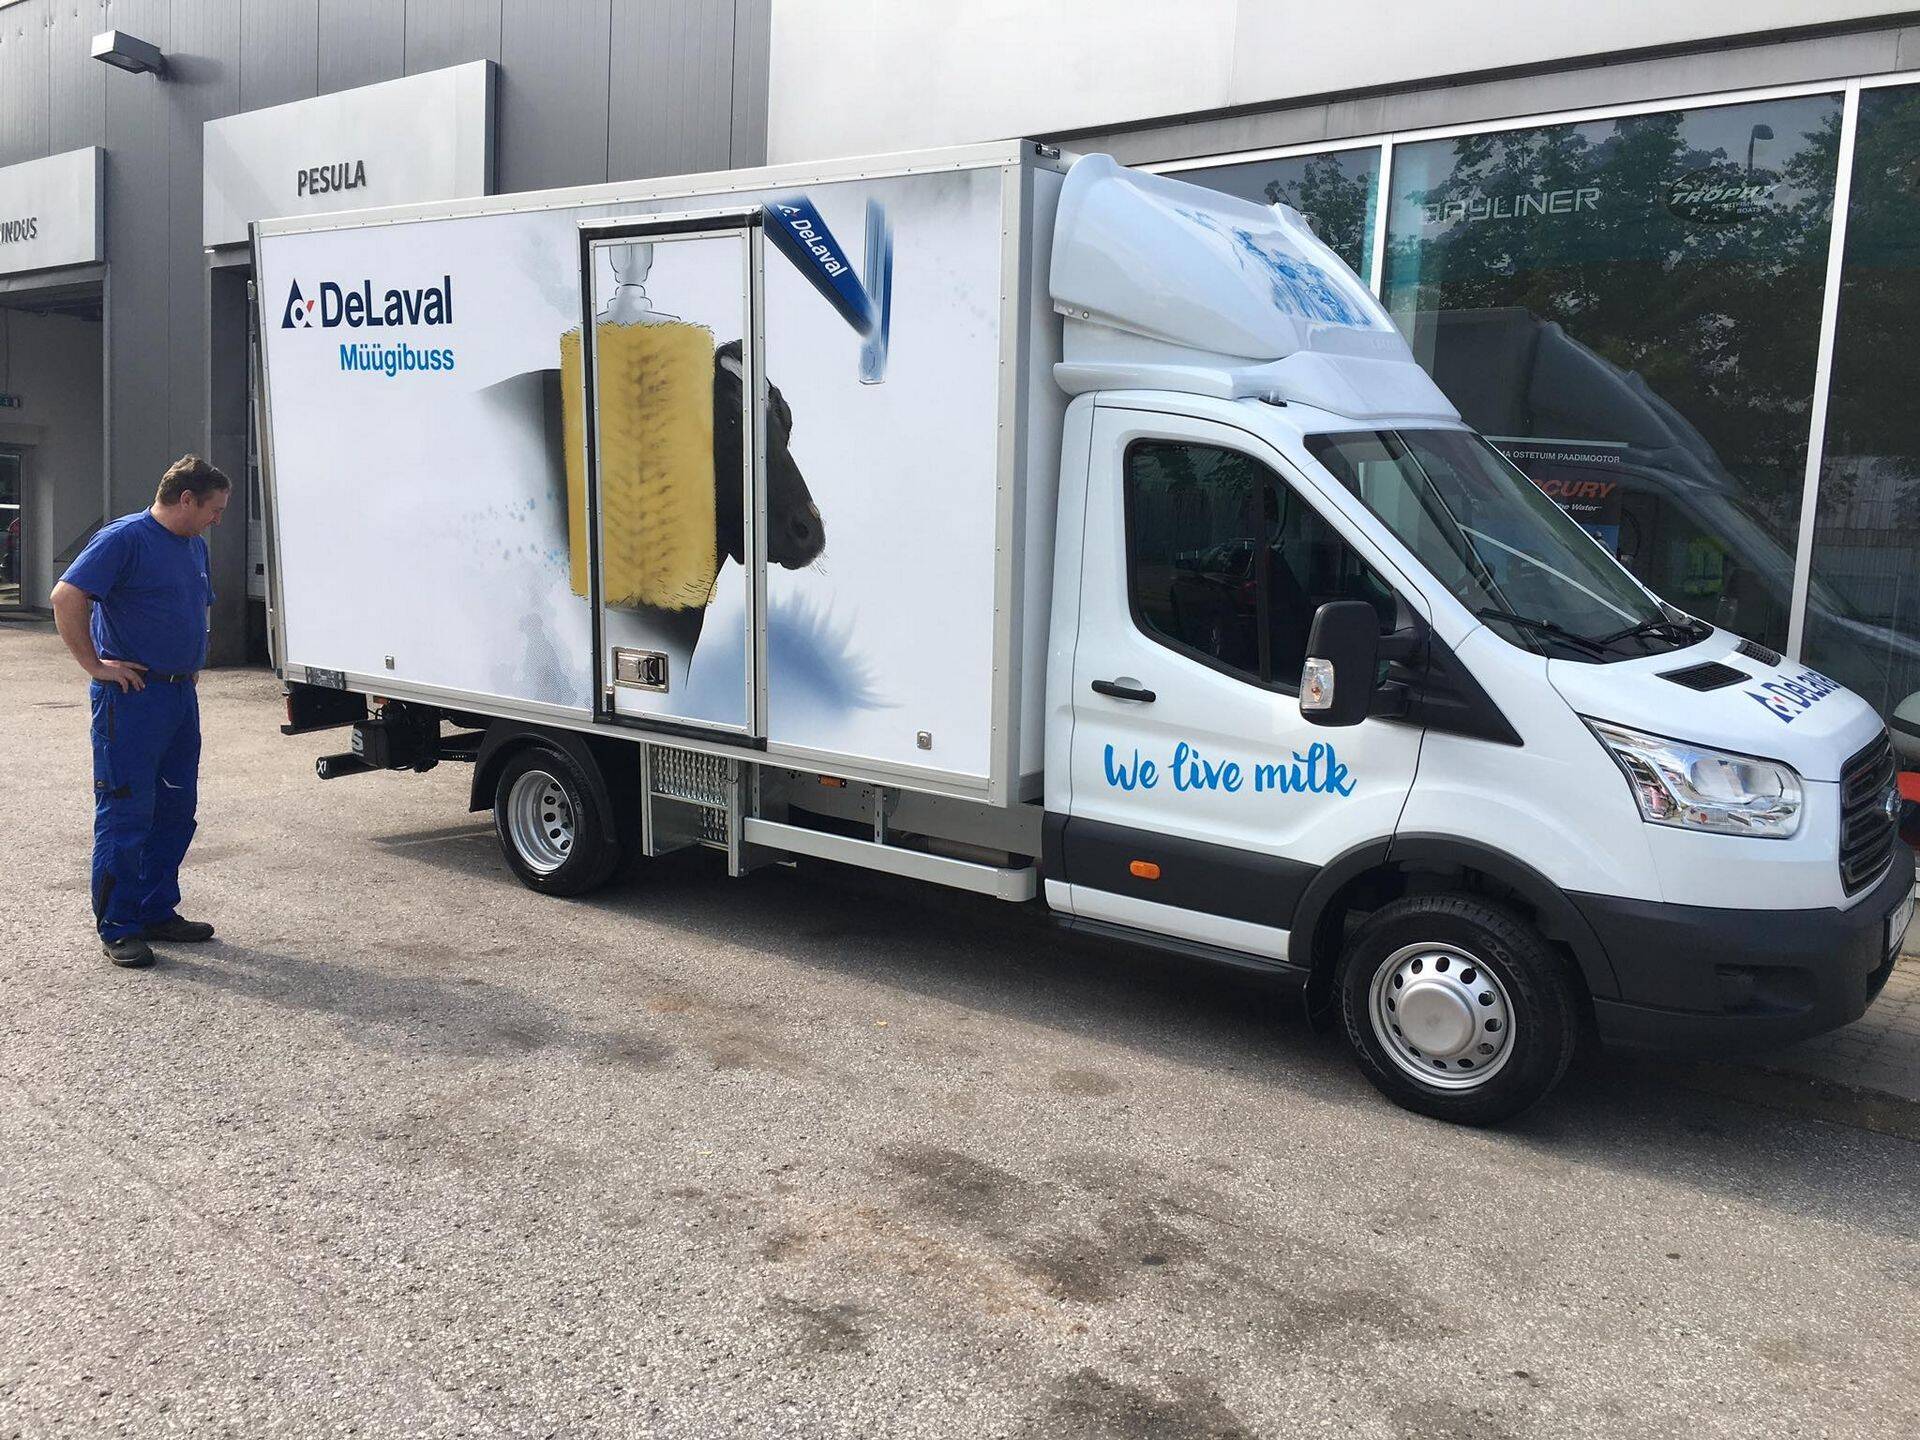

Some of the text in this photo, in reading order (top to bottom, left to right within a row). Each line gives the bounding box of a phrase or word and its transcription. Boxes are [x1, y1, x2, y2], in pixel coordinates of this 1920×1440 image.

[297, 159, 367, 197] PESULA
[0, 217, 38, 244] INDUS
[790, 219, 849, 277] DeLaval
[319, 275, 453, 328] DeLaval
[339, 342, 455, 378] Müügibuss
[1513, 450, 1556, 459] OSTETUIM
[1558, 452, 1620, 463] PAADIMOOTOR
[1103, 741, 1358, 798] We live milk
